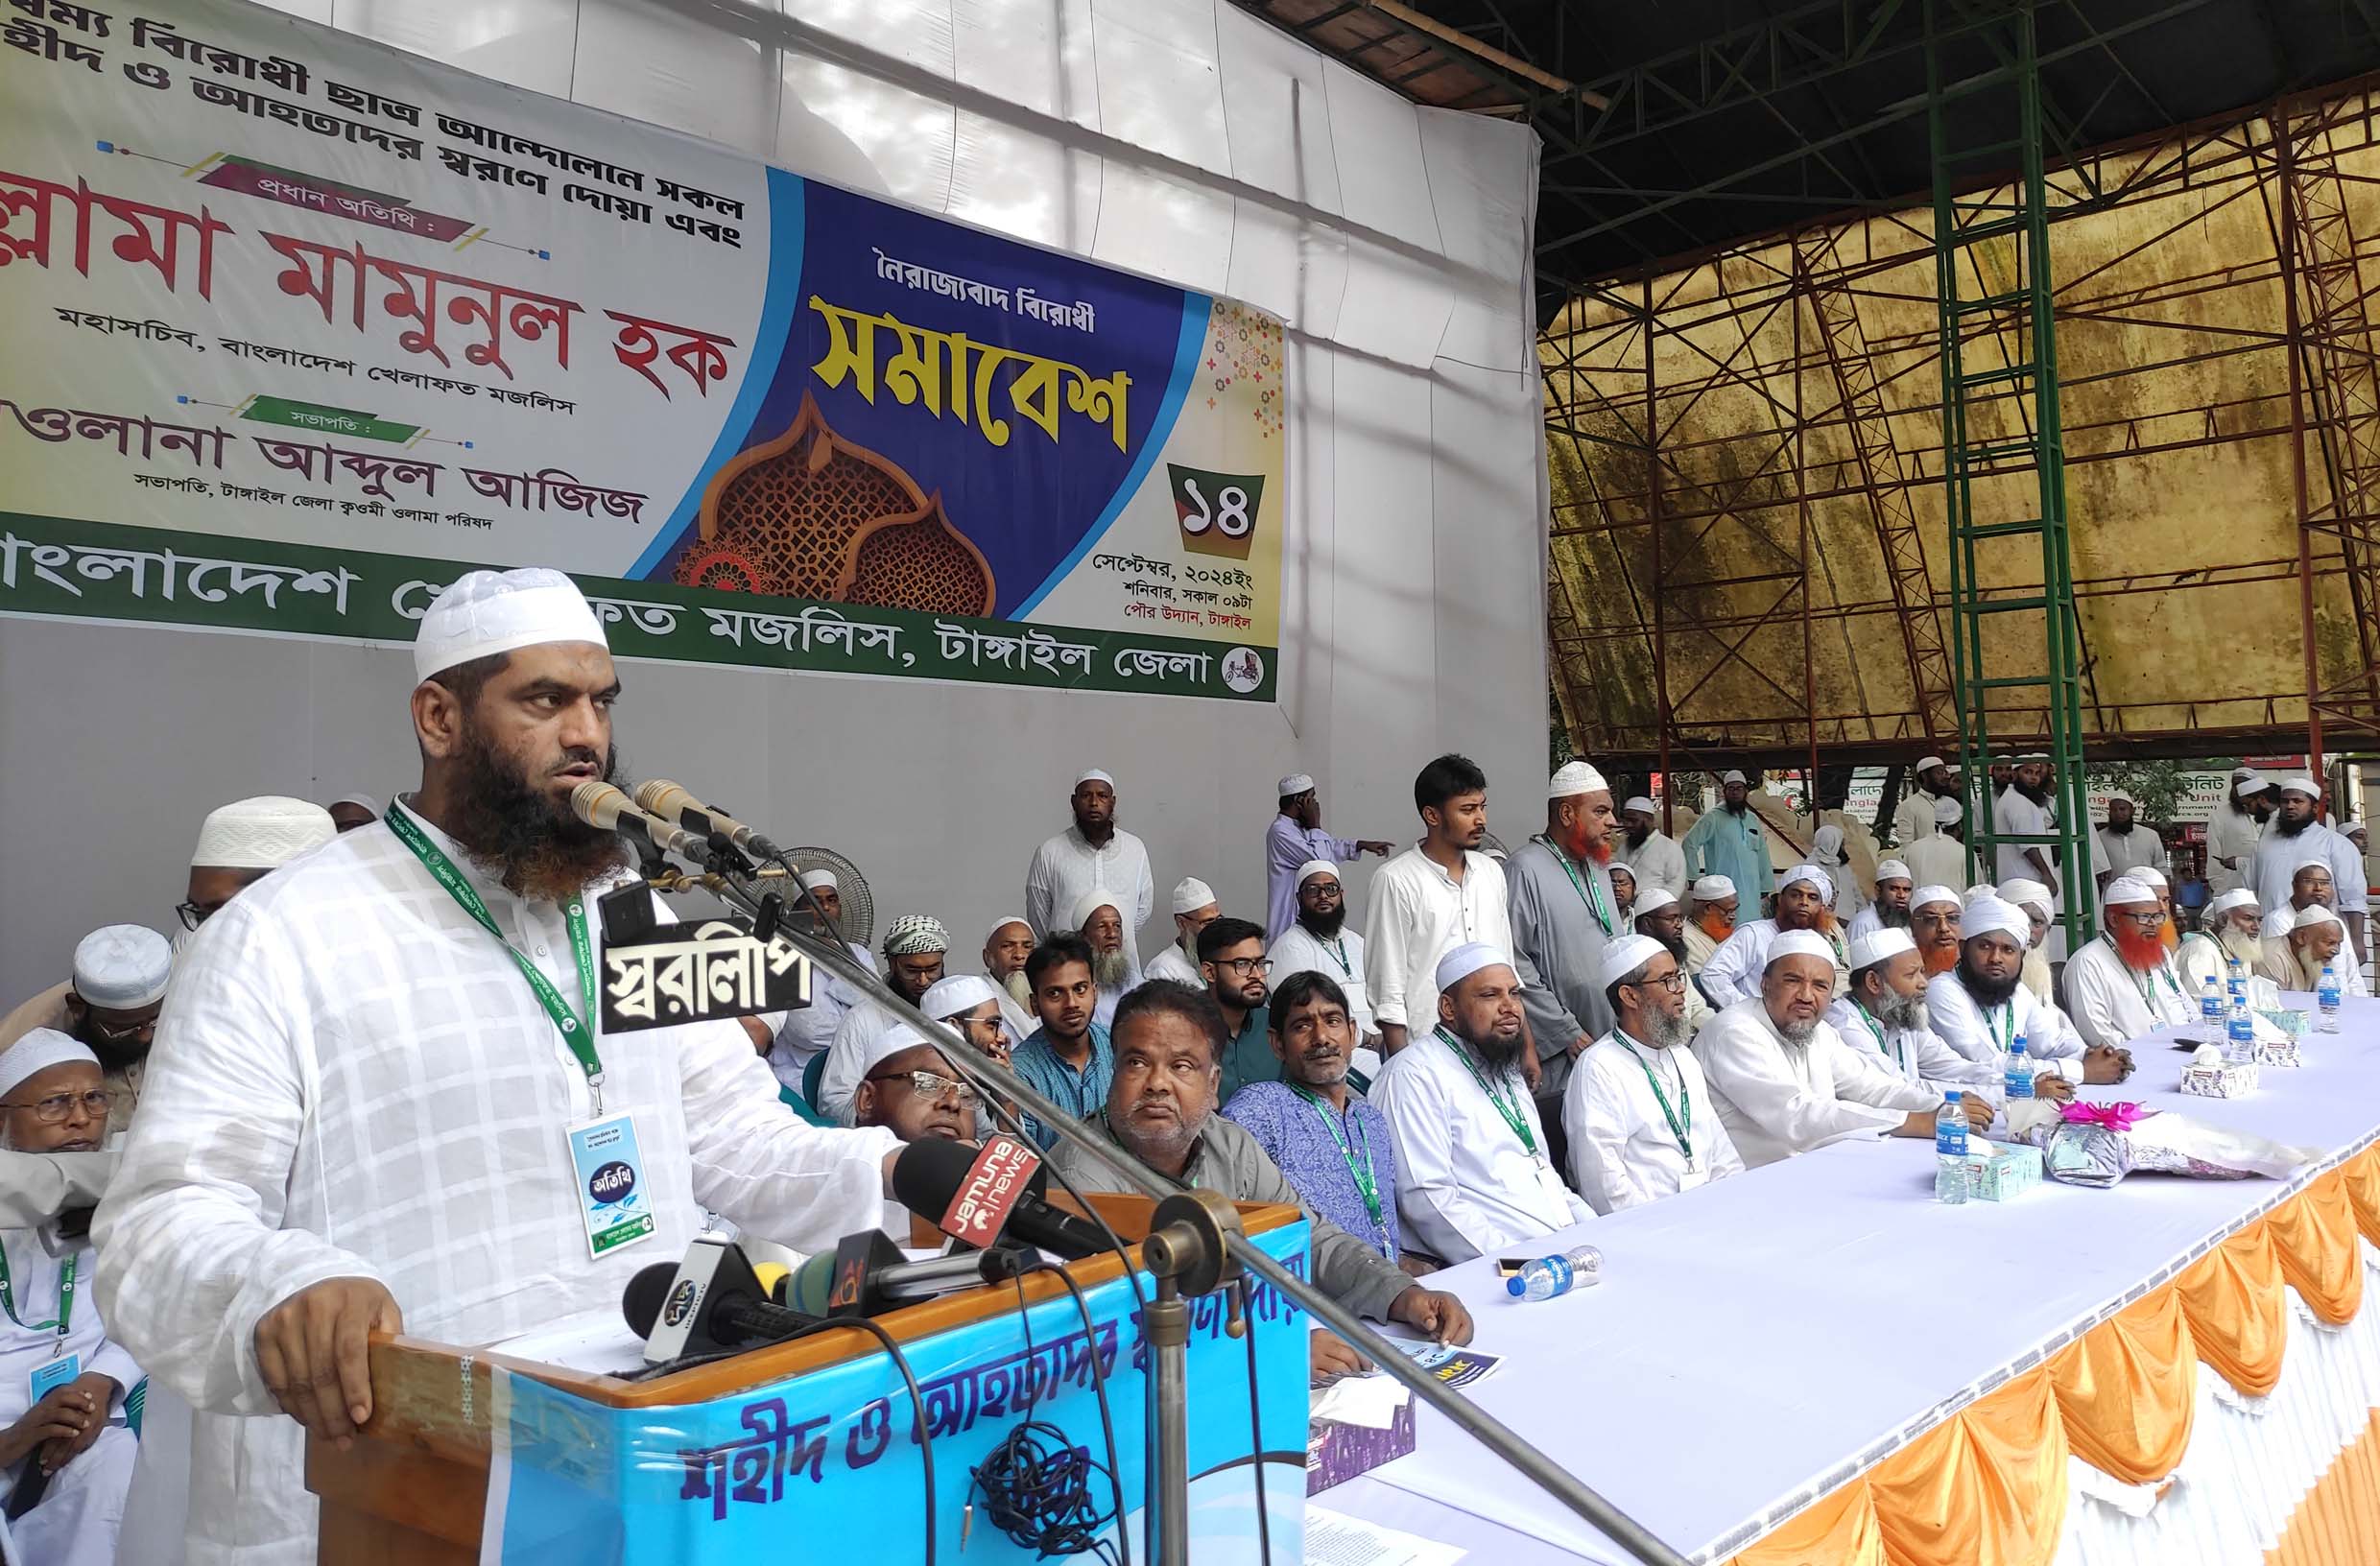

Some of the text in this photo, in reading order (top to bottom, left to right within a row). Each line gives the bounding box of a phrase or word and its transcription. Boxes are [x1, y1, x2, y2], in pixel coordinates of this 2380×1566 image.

[123, 62, 171, 89] ও
[189, 76, 423, 160] আহতদের
[562, 183, 653, 224] দোয়া
[665, 213, 741, 249] এবং
[130, 17, 310, 95] বিরোধী
[324, 80, 422, 127] ছাত্র
[435, 112, 645, 192] আন্দোলনে
[655, 178, 745, 220] সকল
[257, 178, 330, 207] প্রধান
[335, 199, 417, 228] অতিথি
[258, 230, 584, 381] মামুনুল
[603, 309, 737, 401] হক
[871, 247, 1096, 334] নৈরাজ্যবাদ বিরোধী
[54, 307, 578, 415] মহাসচিব, বাংলাদেশ খেলাফত মজলিস
[808, 295, 1133, 454] সমাবেশ
[291, 411, 360, 432] সভাপতি
[133, 473, 214, 499] সভাপতি,
[220, 481, 286, 505] টাঙ্গাইল
[292, 494, 335, 511] জেলা
[392, 506, 439, 524] ওলামা
[444, 511, 493, 531] পরিষদ
[251, 437, 446, 502] আব্দুল
[460, 467, 650, 524] আজিজ
[1181, 478, 1251, 536] ১৪
[0, 531, 364, 615] াংলাদেশ
[1092, 553, 1254, 592] সেপ্টেম্বর, ২০২৪ইং
[1123, 581, 1253, 610] শনিবার, সকাল ০৯টা
[699, 606, 916, 668] মজলিস,
[933, 617, 1100, 677] টাঙ্গাইল
[1113, 647, 1214, 684] জেলা
[1125, 601, 1252, 630] পৌর উদ্যান, টাঙ্গাইল
[592, 1165, 632, 1193] অতিথি
[677, 1396, 831, 1521] শহীদ
[845, 1396, 891, 1469] ও
